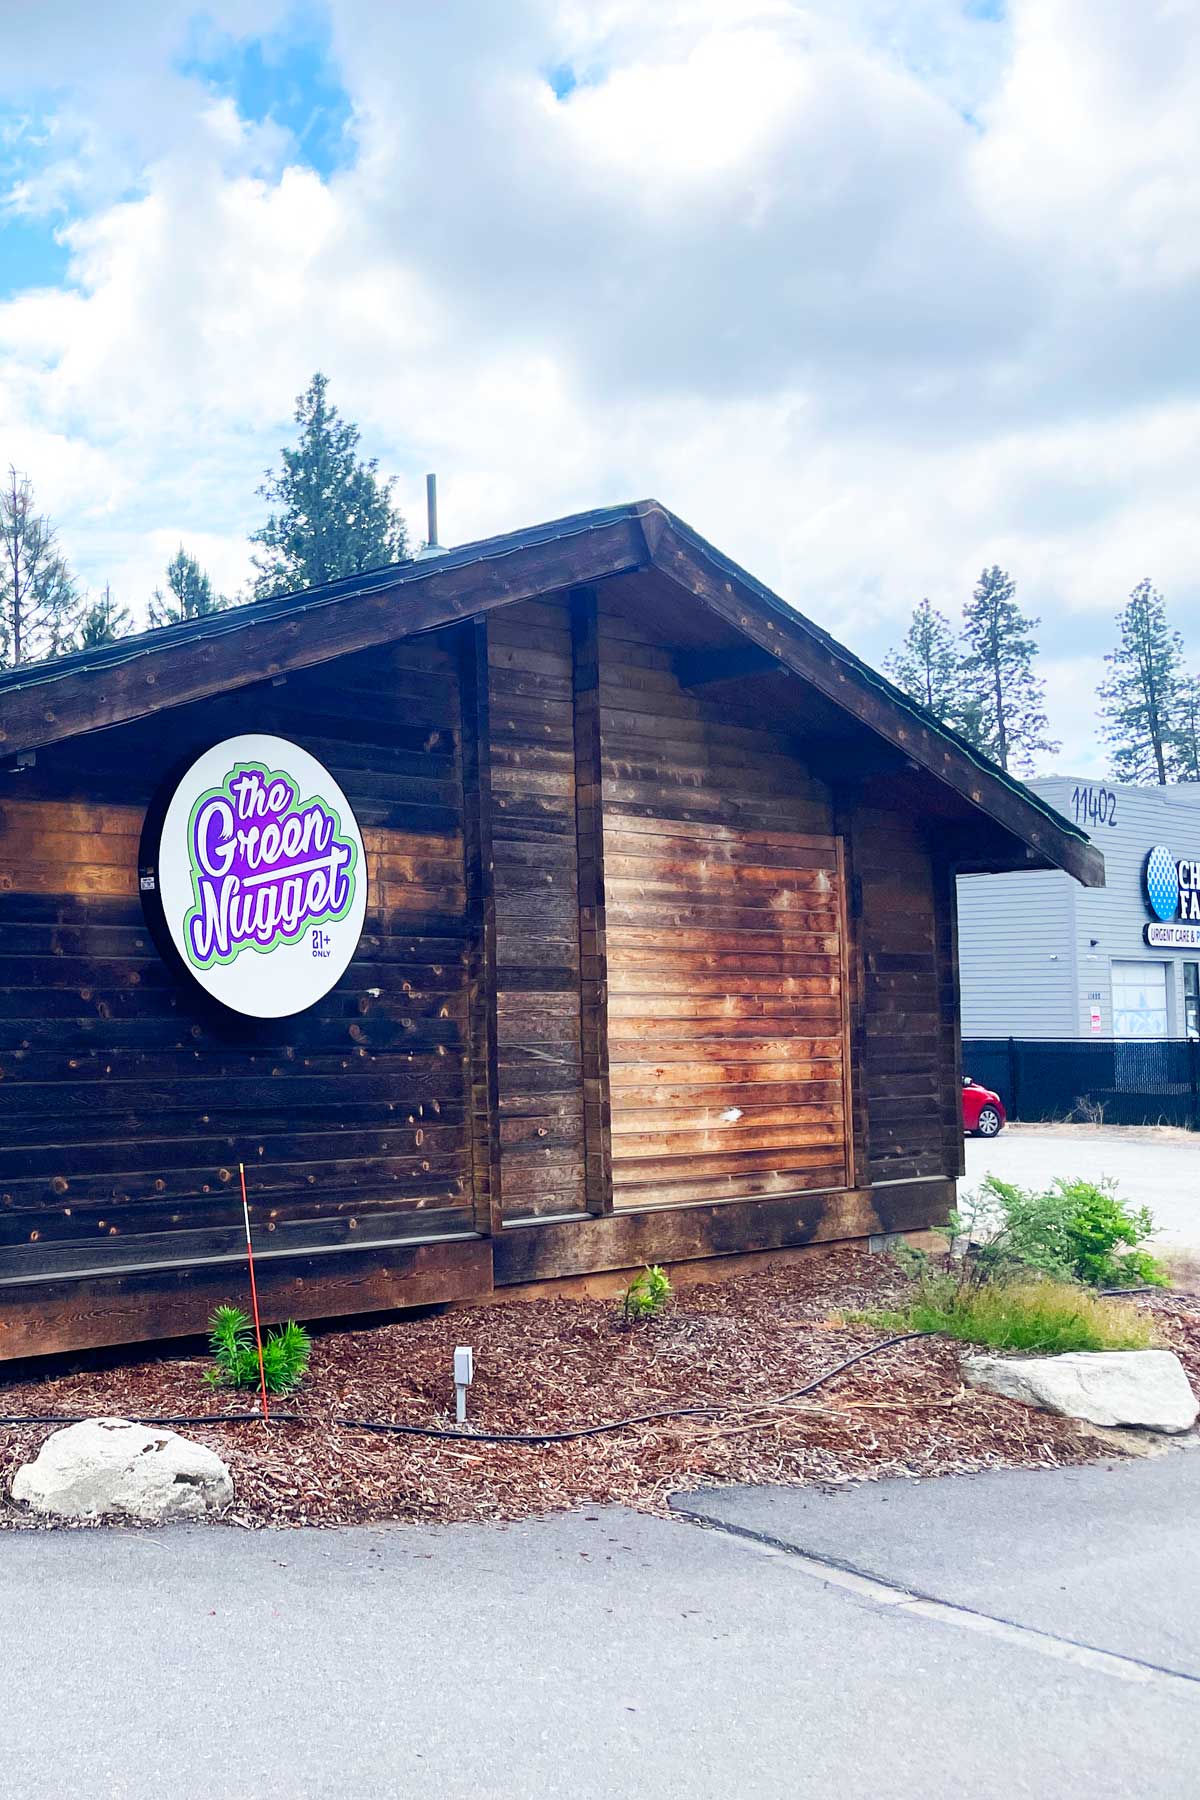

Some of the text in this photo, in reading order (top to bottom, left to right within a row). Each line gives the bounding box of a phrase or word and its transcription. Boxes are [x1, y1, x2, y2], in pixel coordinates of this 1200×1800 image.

[233, 776, 290, 819] the
[1071, 786, 1117, 827] 11402
[198, 801, 332, 877] Green
[192, 847, 349, 957] Nugget
[312, 930, 331, 949] 21+
[312, 950, 331, 958] ONLY
[1151, 928, 1174, 942] URGENT
[1175, 929, 1190, 943] CARE
